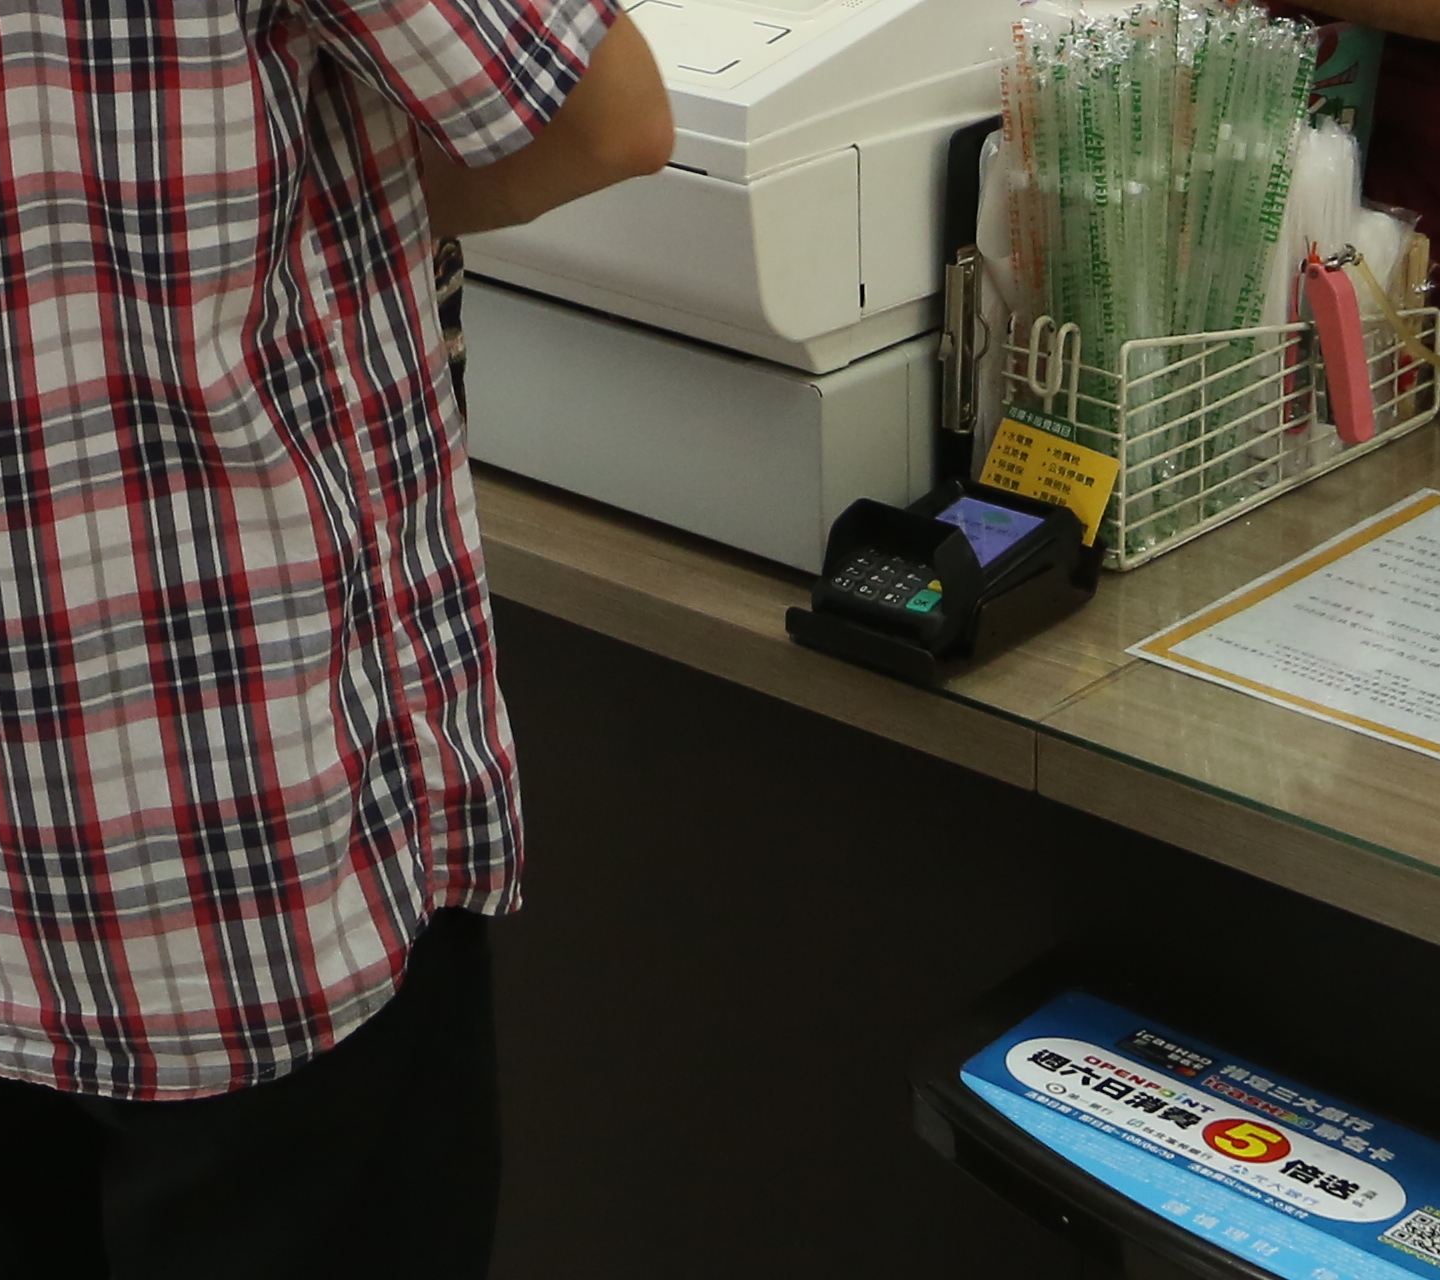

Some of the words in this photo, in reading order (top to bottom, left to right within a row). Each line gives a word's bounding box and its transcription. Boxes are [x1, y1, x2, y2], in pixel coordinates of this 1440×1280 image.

[1027, 1049, 1203, 1131] 週六日消費
[1214, 1121, 1285, 1159] 5
[1278, 1159, 1362, 1202] 倍送
[1220, 1065, 1374, 1134] 指定三大銀行
